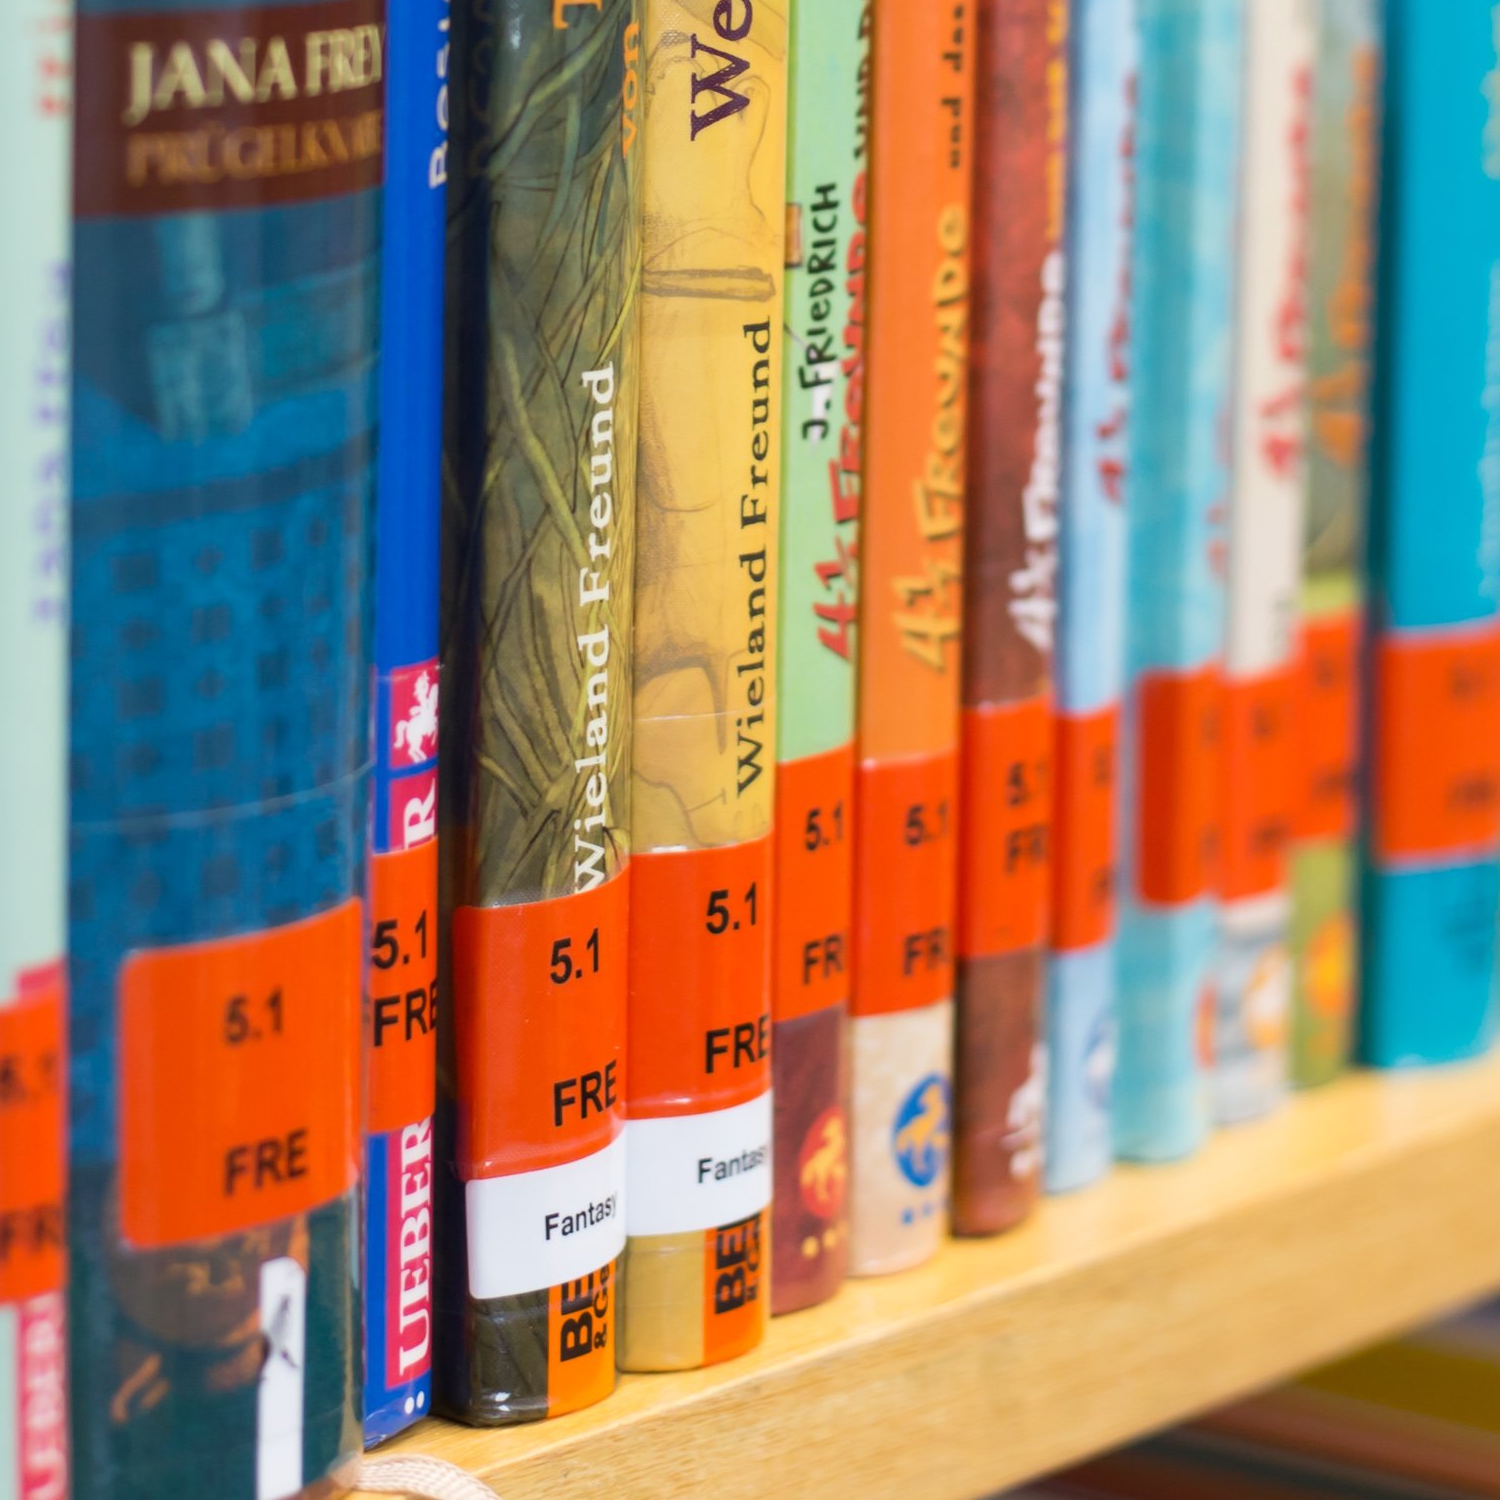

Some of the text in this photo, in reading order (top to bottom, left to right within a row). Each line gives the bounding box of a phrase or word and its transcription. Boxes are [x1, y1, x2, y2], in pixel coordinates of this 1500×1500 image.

[121, 34, 297, 128] JANA
[621, 22, 640, 160] von
[736, 316, 773, 799] Wieland Freund
[574, 361, 615, 894] Wieland Freund
[371, 909, 428, 970] 5.1
[705, 881, 758, 935] 5.1
[550, 927, 600, 985] 5.1
[803, 932, 845, 986] FR
[225, 983, 284, 1047] 5.1
[373, 978, 438, 1047] FRE
[705, 1014, 770, 1074] FRE
[553, 1059, 618, 1127] FRE
[223, 1127, 308, 1197] FRE
[697, 1147, 768, 1185] Fantas
[594, 1263, 611, 1350] & Ge
